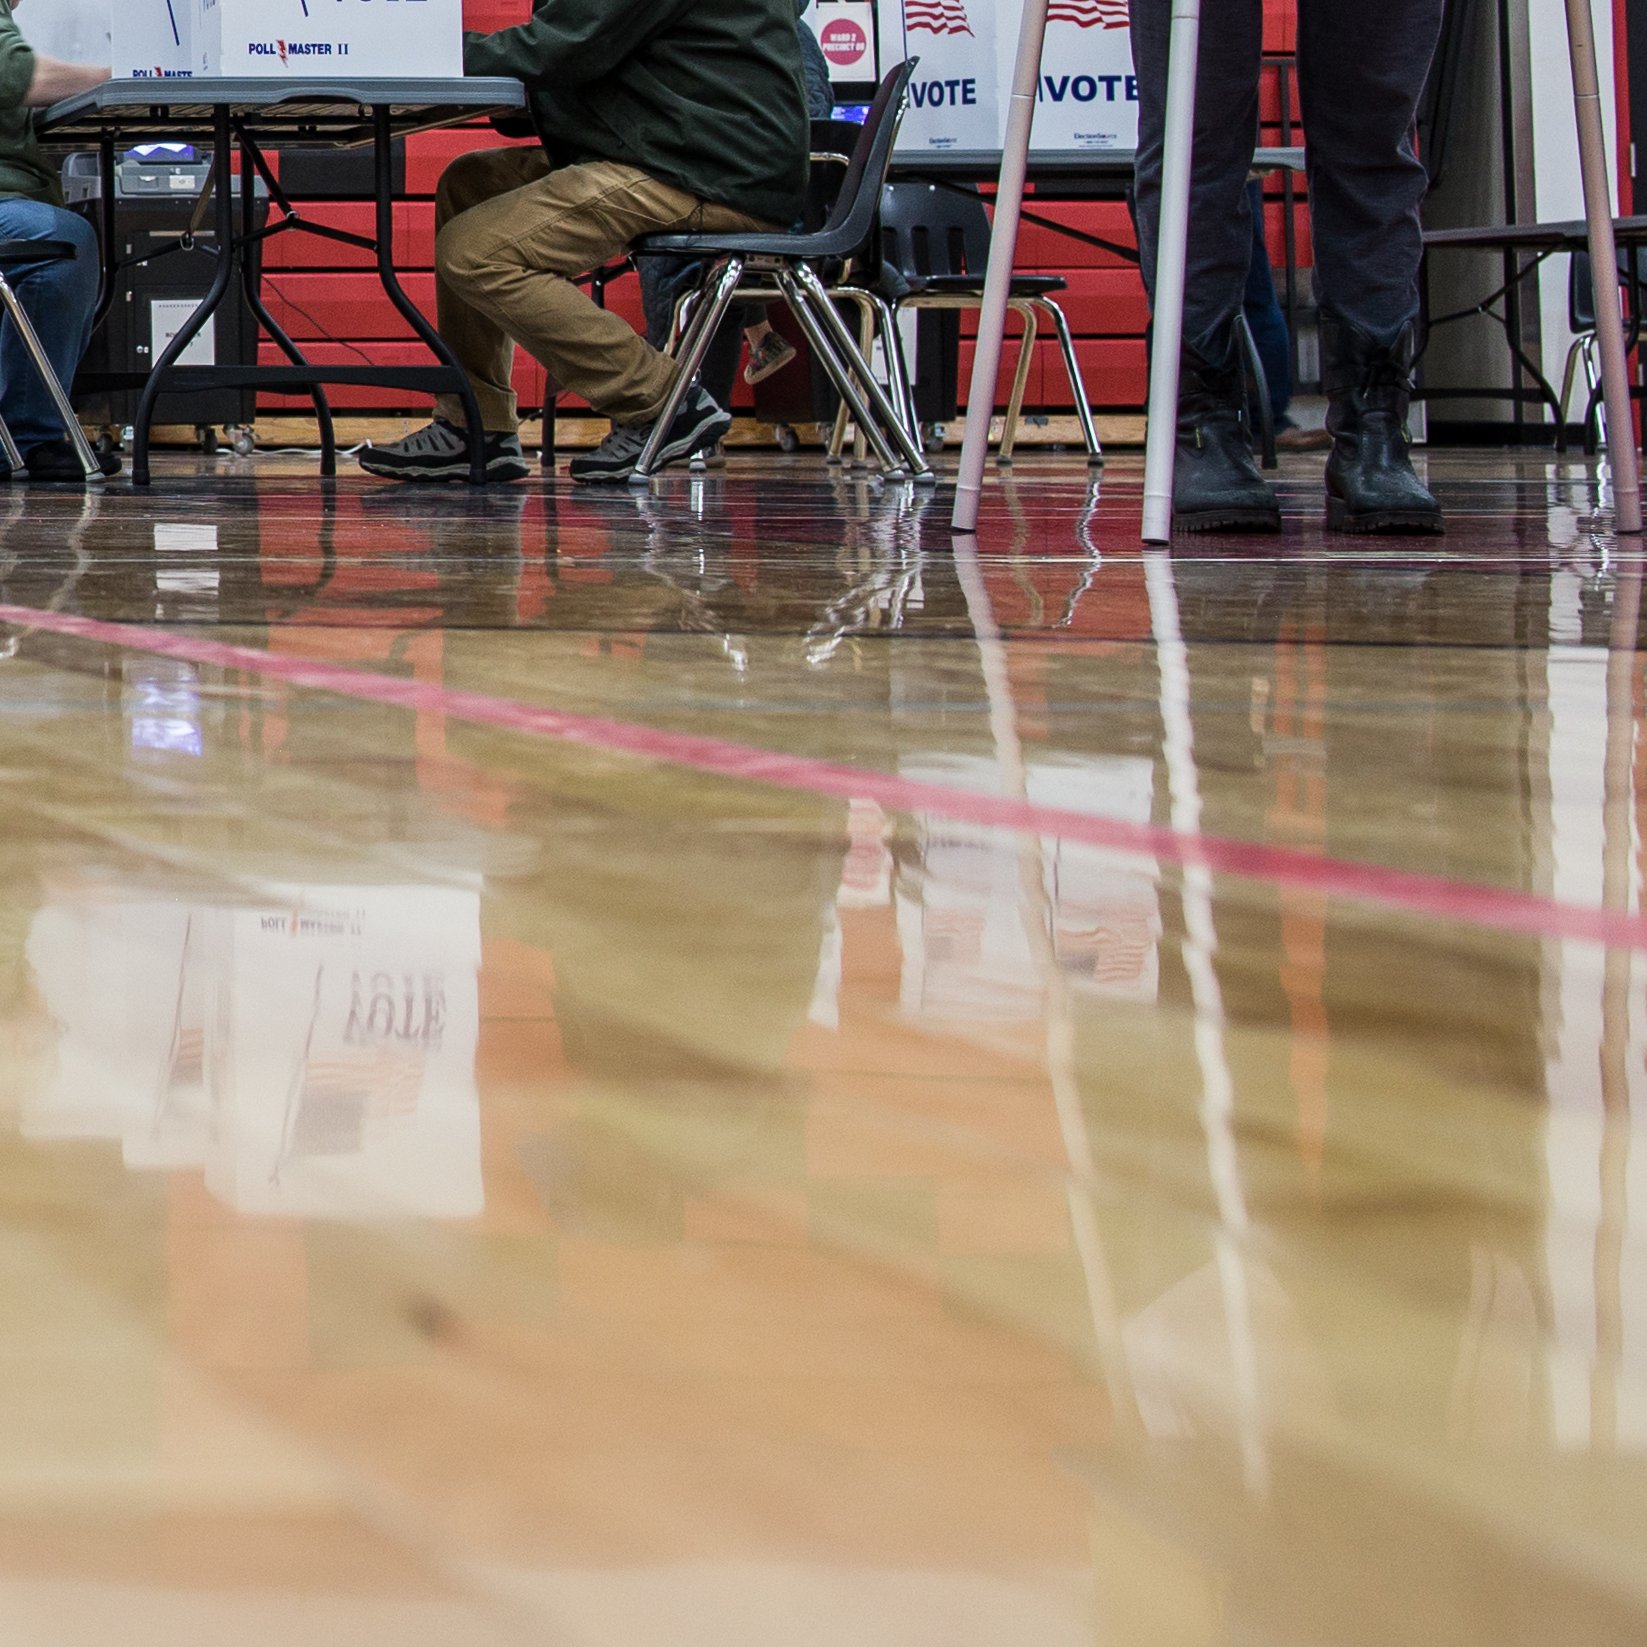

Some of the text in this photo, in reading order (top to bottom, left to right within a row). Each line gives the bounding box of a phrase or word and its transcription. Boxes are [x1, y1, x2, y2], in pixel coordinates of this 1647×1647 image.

[248, 43, 349, 55] POLL MASTER II
[910, 78, 977, 108] VOTE
[1043, 74, 1139, 102] VOTE
